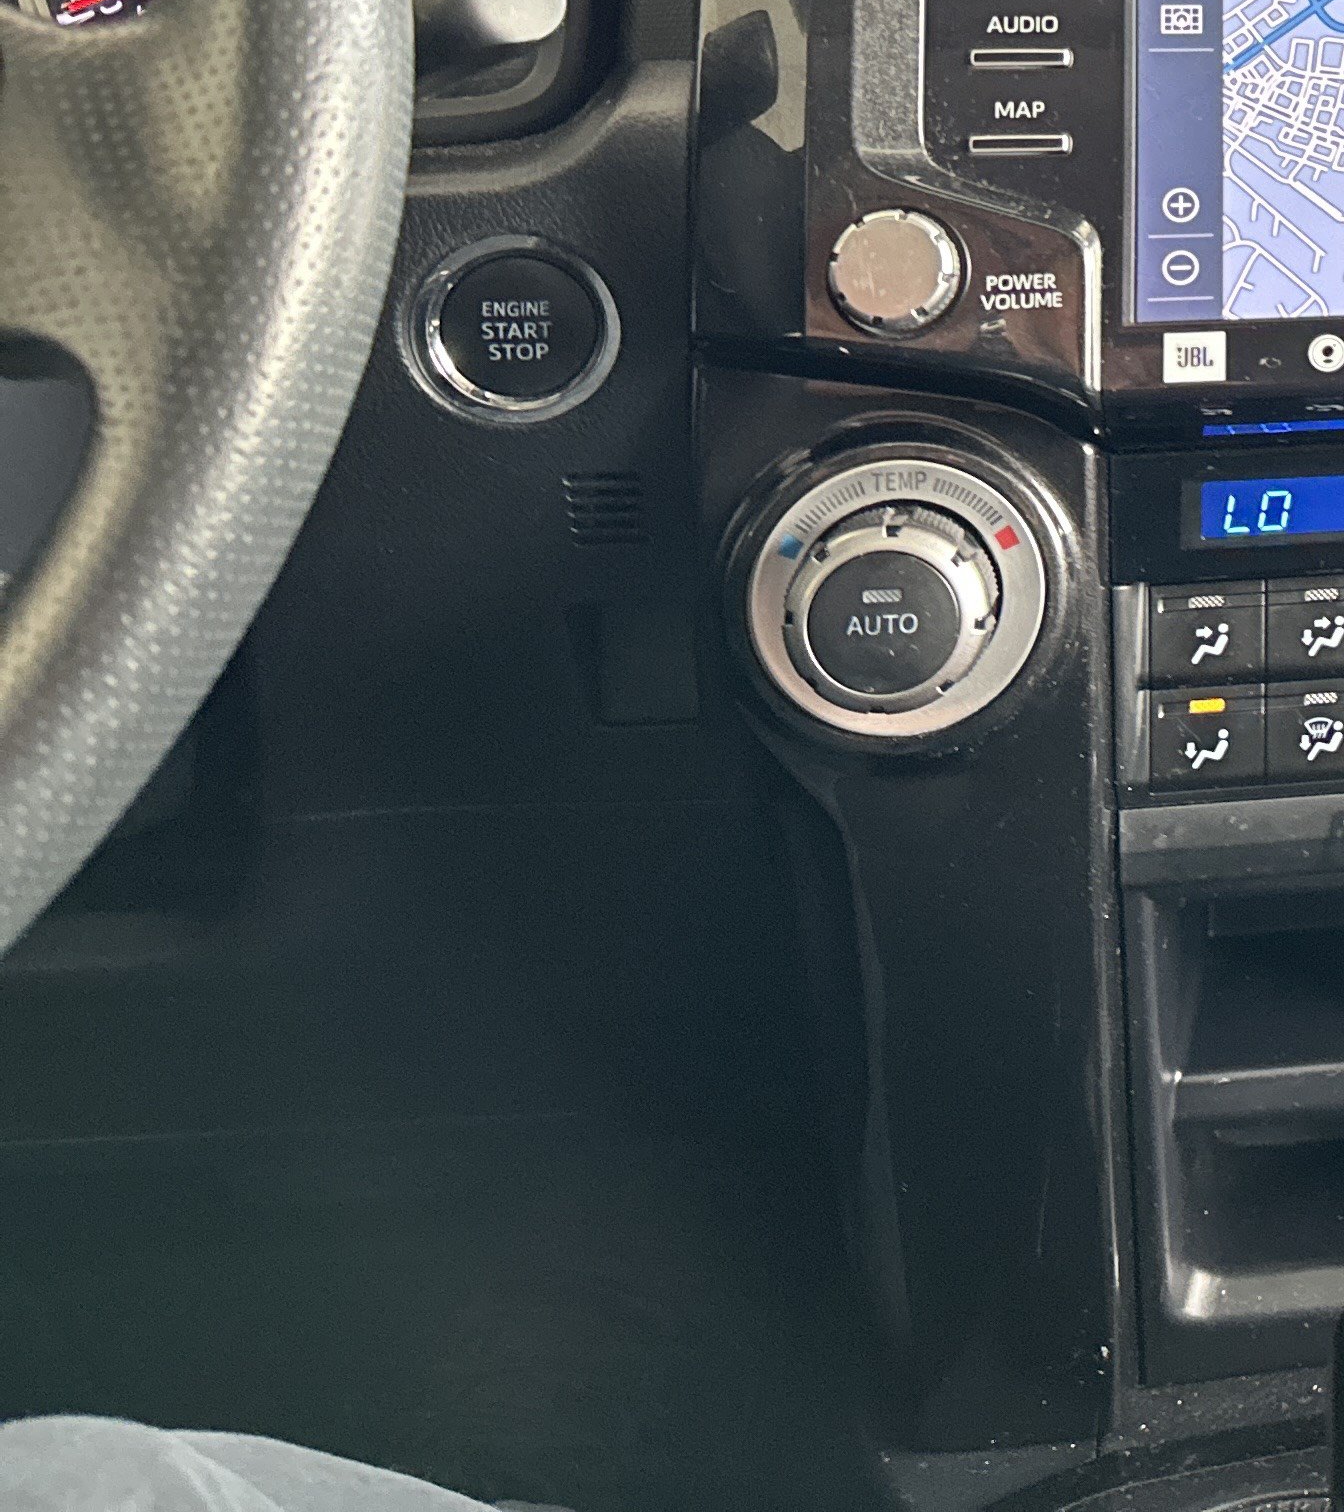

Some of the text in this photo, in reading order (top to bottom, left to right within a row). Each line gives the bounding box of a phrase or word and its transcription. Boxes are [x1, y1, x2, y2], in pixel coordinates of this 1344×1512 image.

[986, 14, 1059, 34] AUDIO
[994, 100, 1046, 120] MAP
[985, 273, 1057, 292] POWER
[481, 300, 550, 318] ENGINE
[980, 292, 1063, 311] VOLUME
[480, 320, 552, 340] START
[488, 342, 550, 361] STOP
[870, 470, 928, 493] TEMP
[846, 612, 919, 636] AUTO
